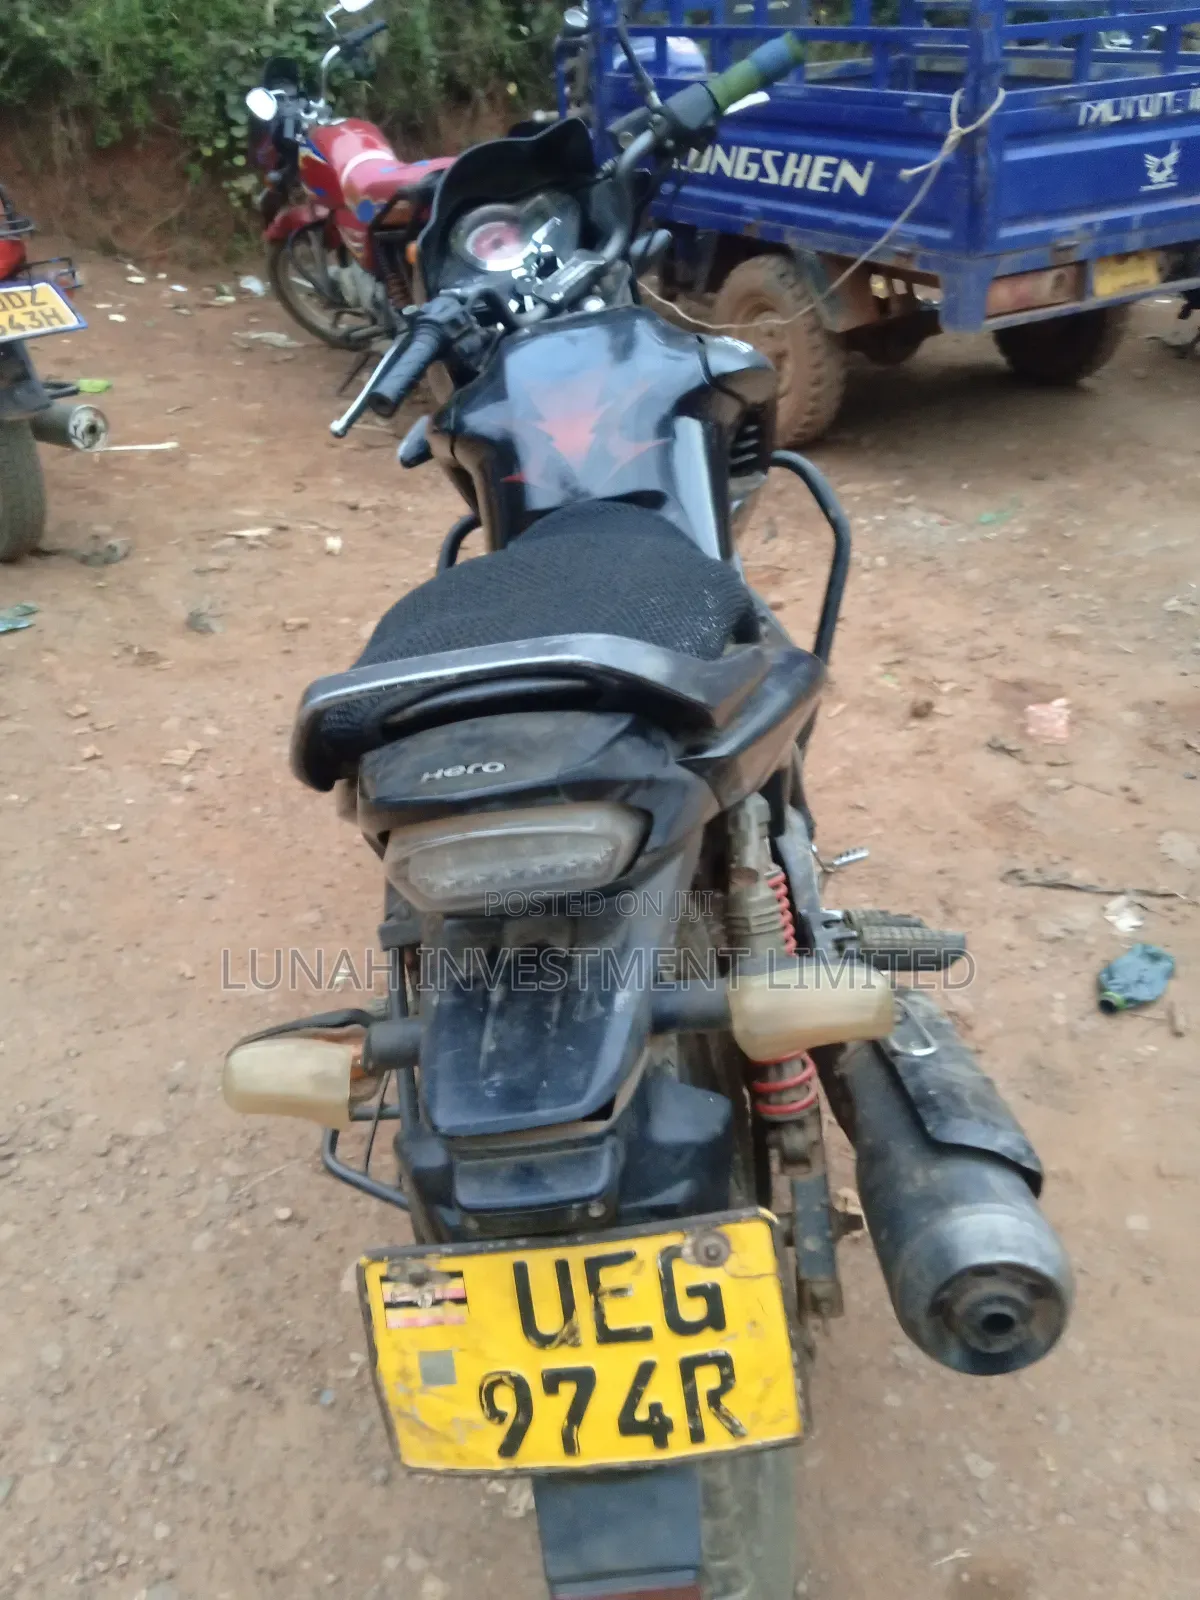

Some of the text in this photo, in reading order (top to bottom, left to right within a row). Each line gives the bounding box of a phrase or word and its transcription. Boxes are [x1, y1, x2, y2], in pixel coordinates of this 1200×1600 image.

[672, 143, 875, 197] ONGSHEN
[512, 1244, 727, 1350] UEG
[478, 1349, 748, 1459] 974R
